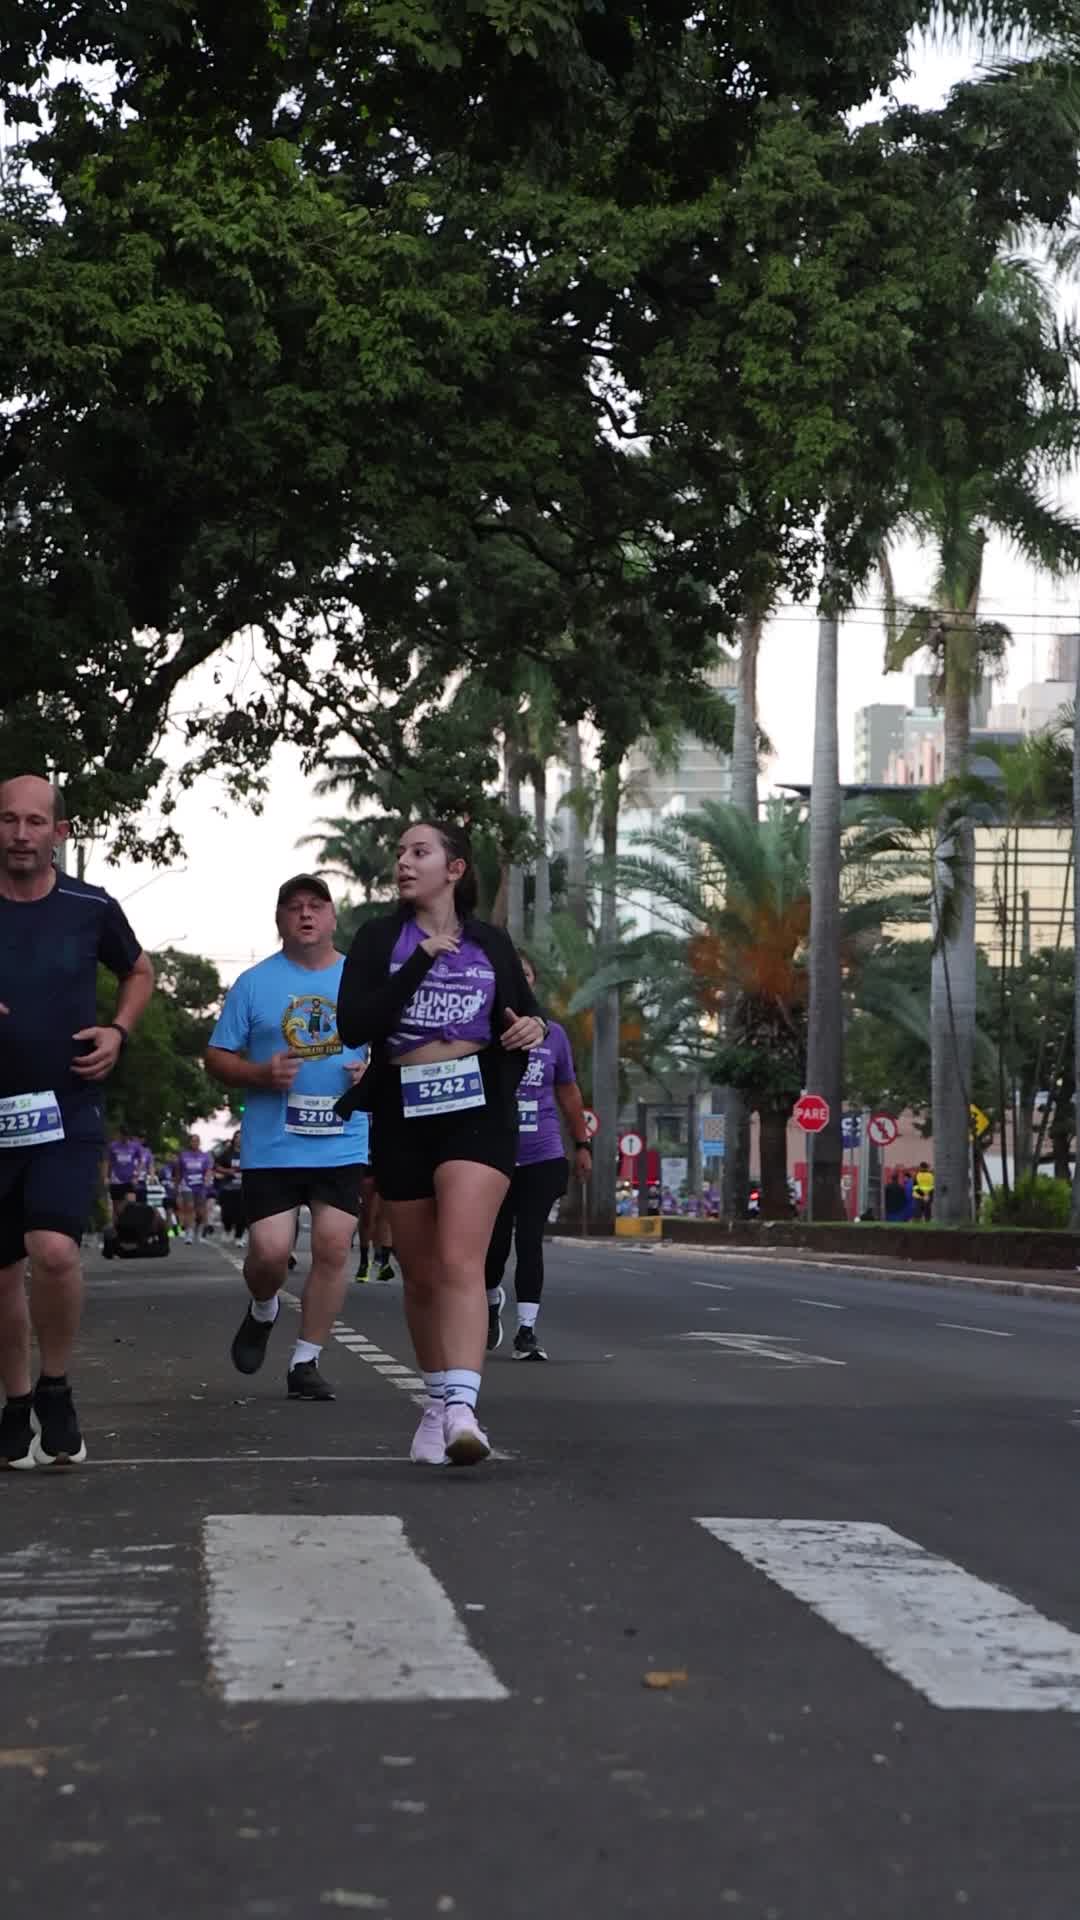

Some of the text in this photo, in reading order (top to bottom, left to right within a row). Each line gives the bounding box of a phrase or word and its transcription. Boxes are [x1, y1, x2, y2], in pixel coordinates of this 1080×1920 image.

[419, 1078, 465, 1098] 5242
[298, 1110, 334, 1122] 5210
[798, 1108, 827, 1120] PARE
